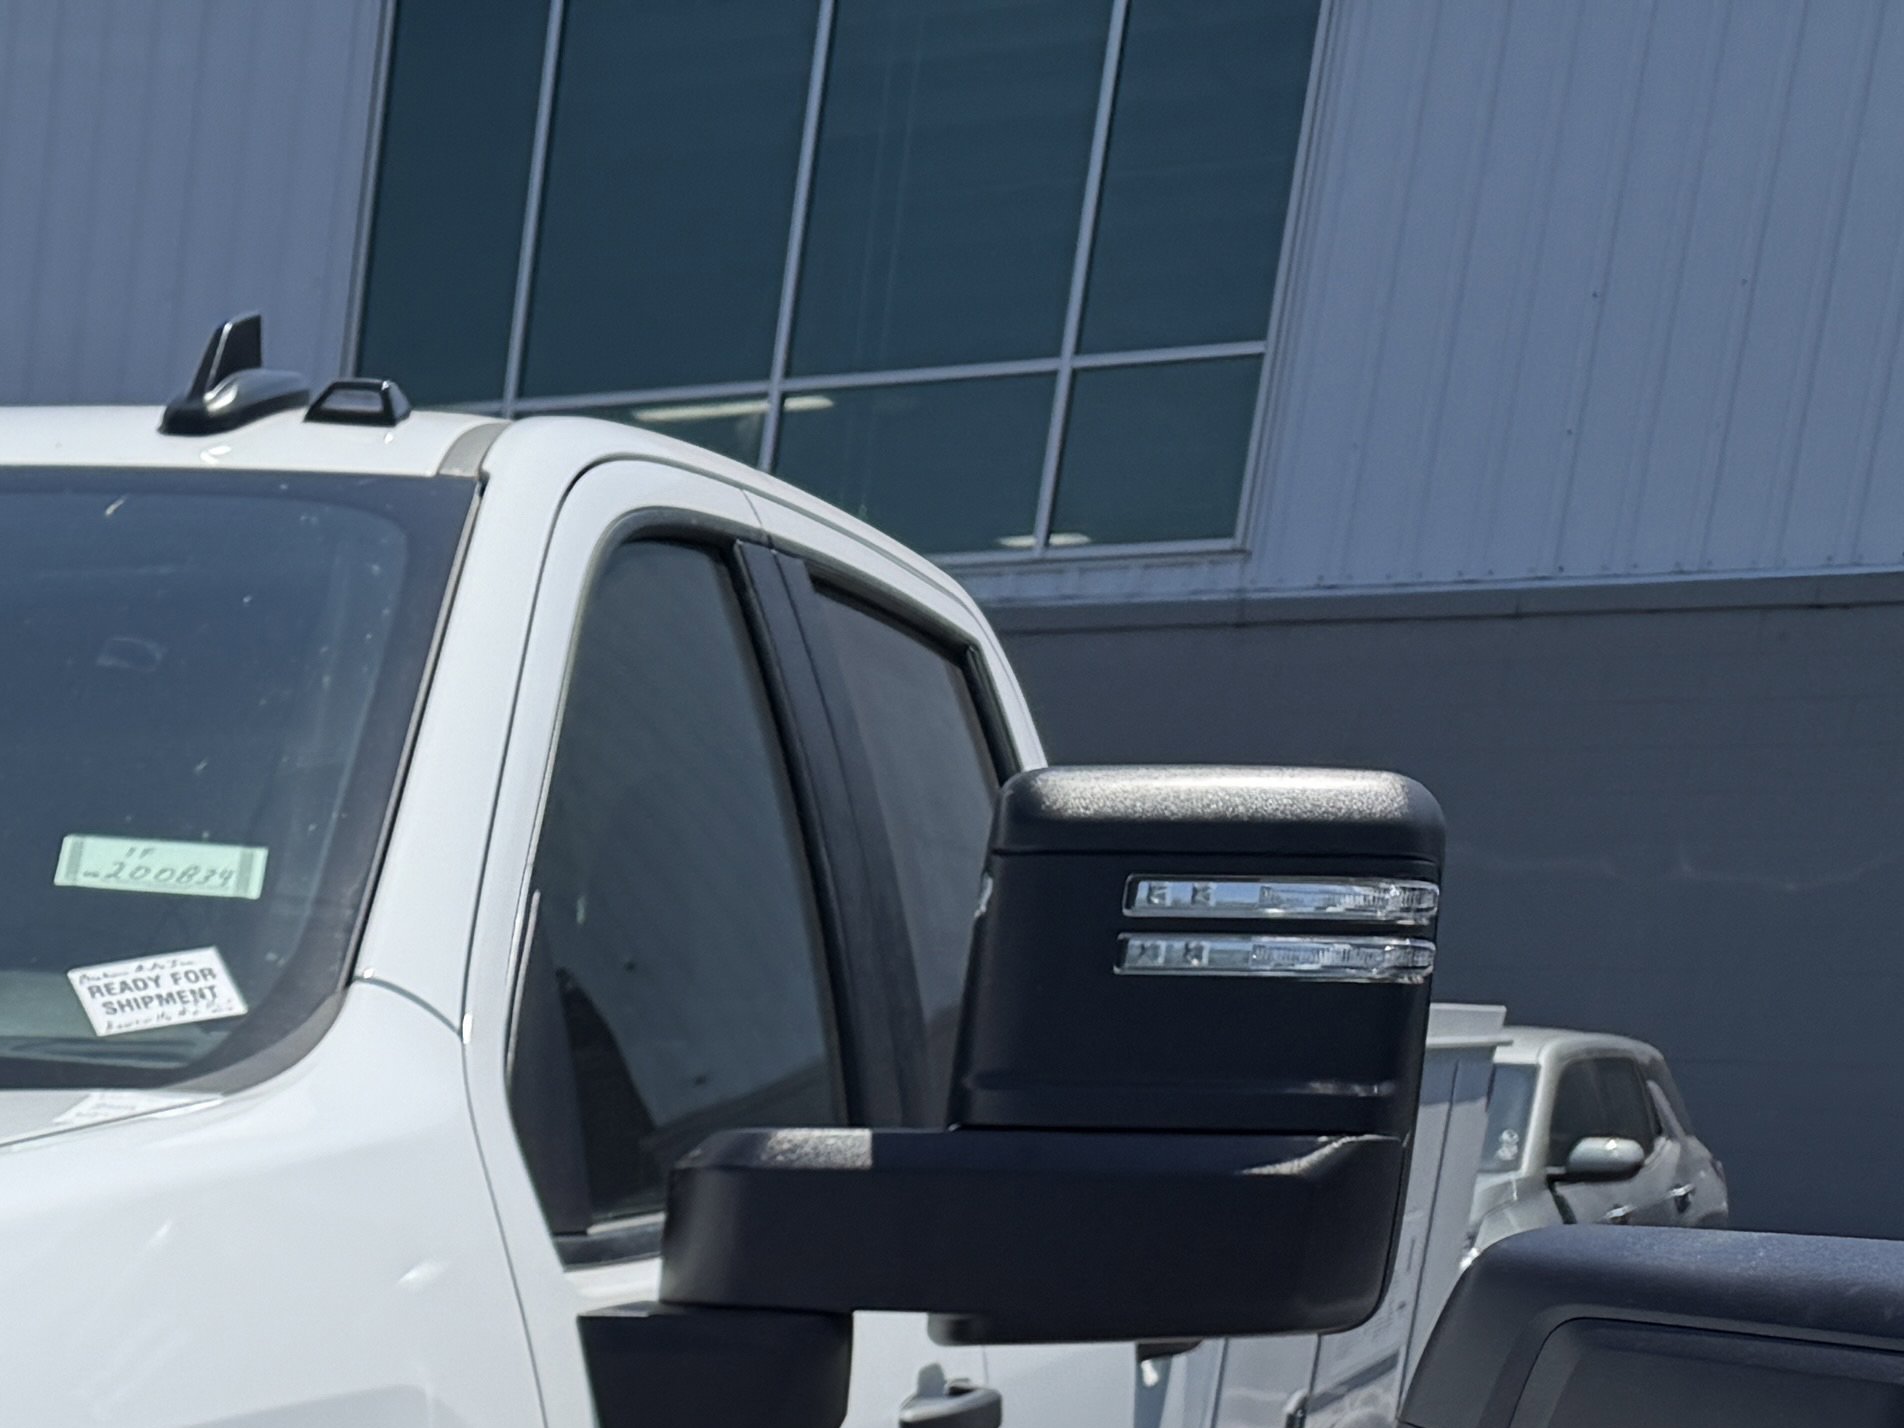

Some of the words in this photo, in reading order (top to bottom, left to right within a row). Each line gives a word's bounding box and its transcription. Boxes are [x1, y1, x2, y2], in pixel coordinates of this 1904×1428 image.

[87, 975, 162, 999] READY
[170, 967, 217, 986] FOR
[101, 985, 218, 1016] SHIPMENT
